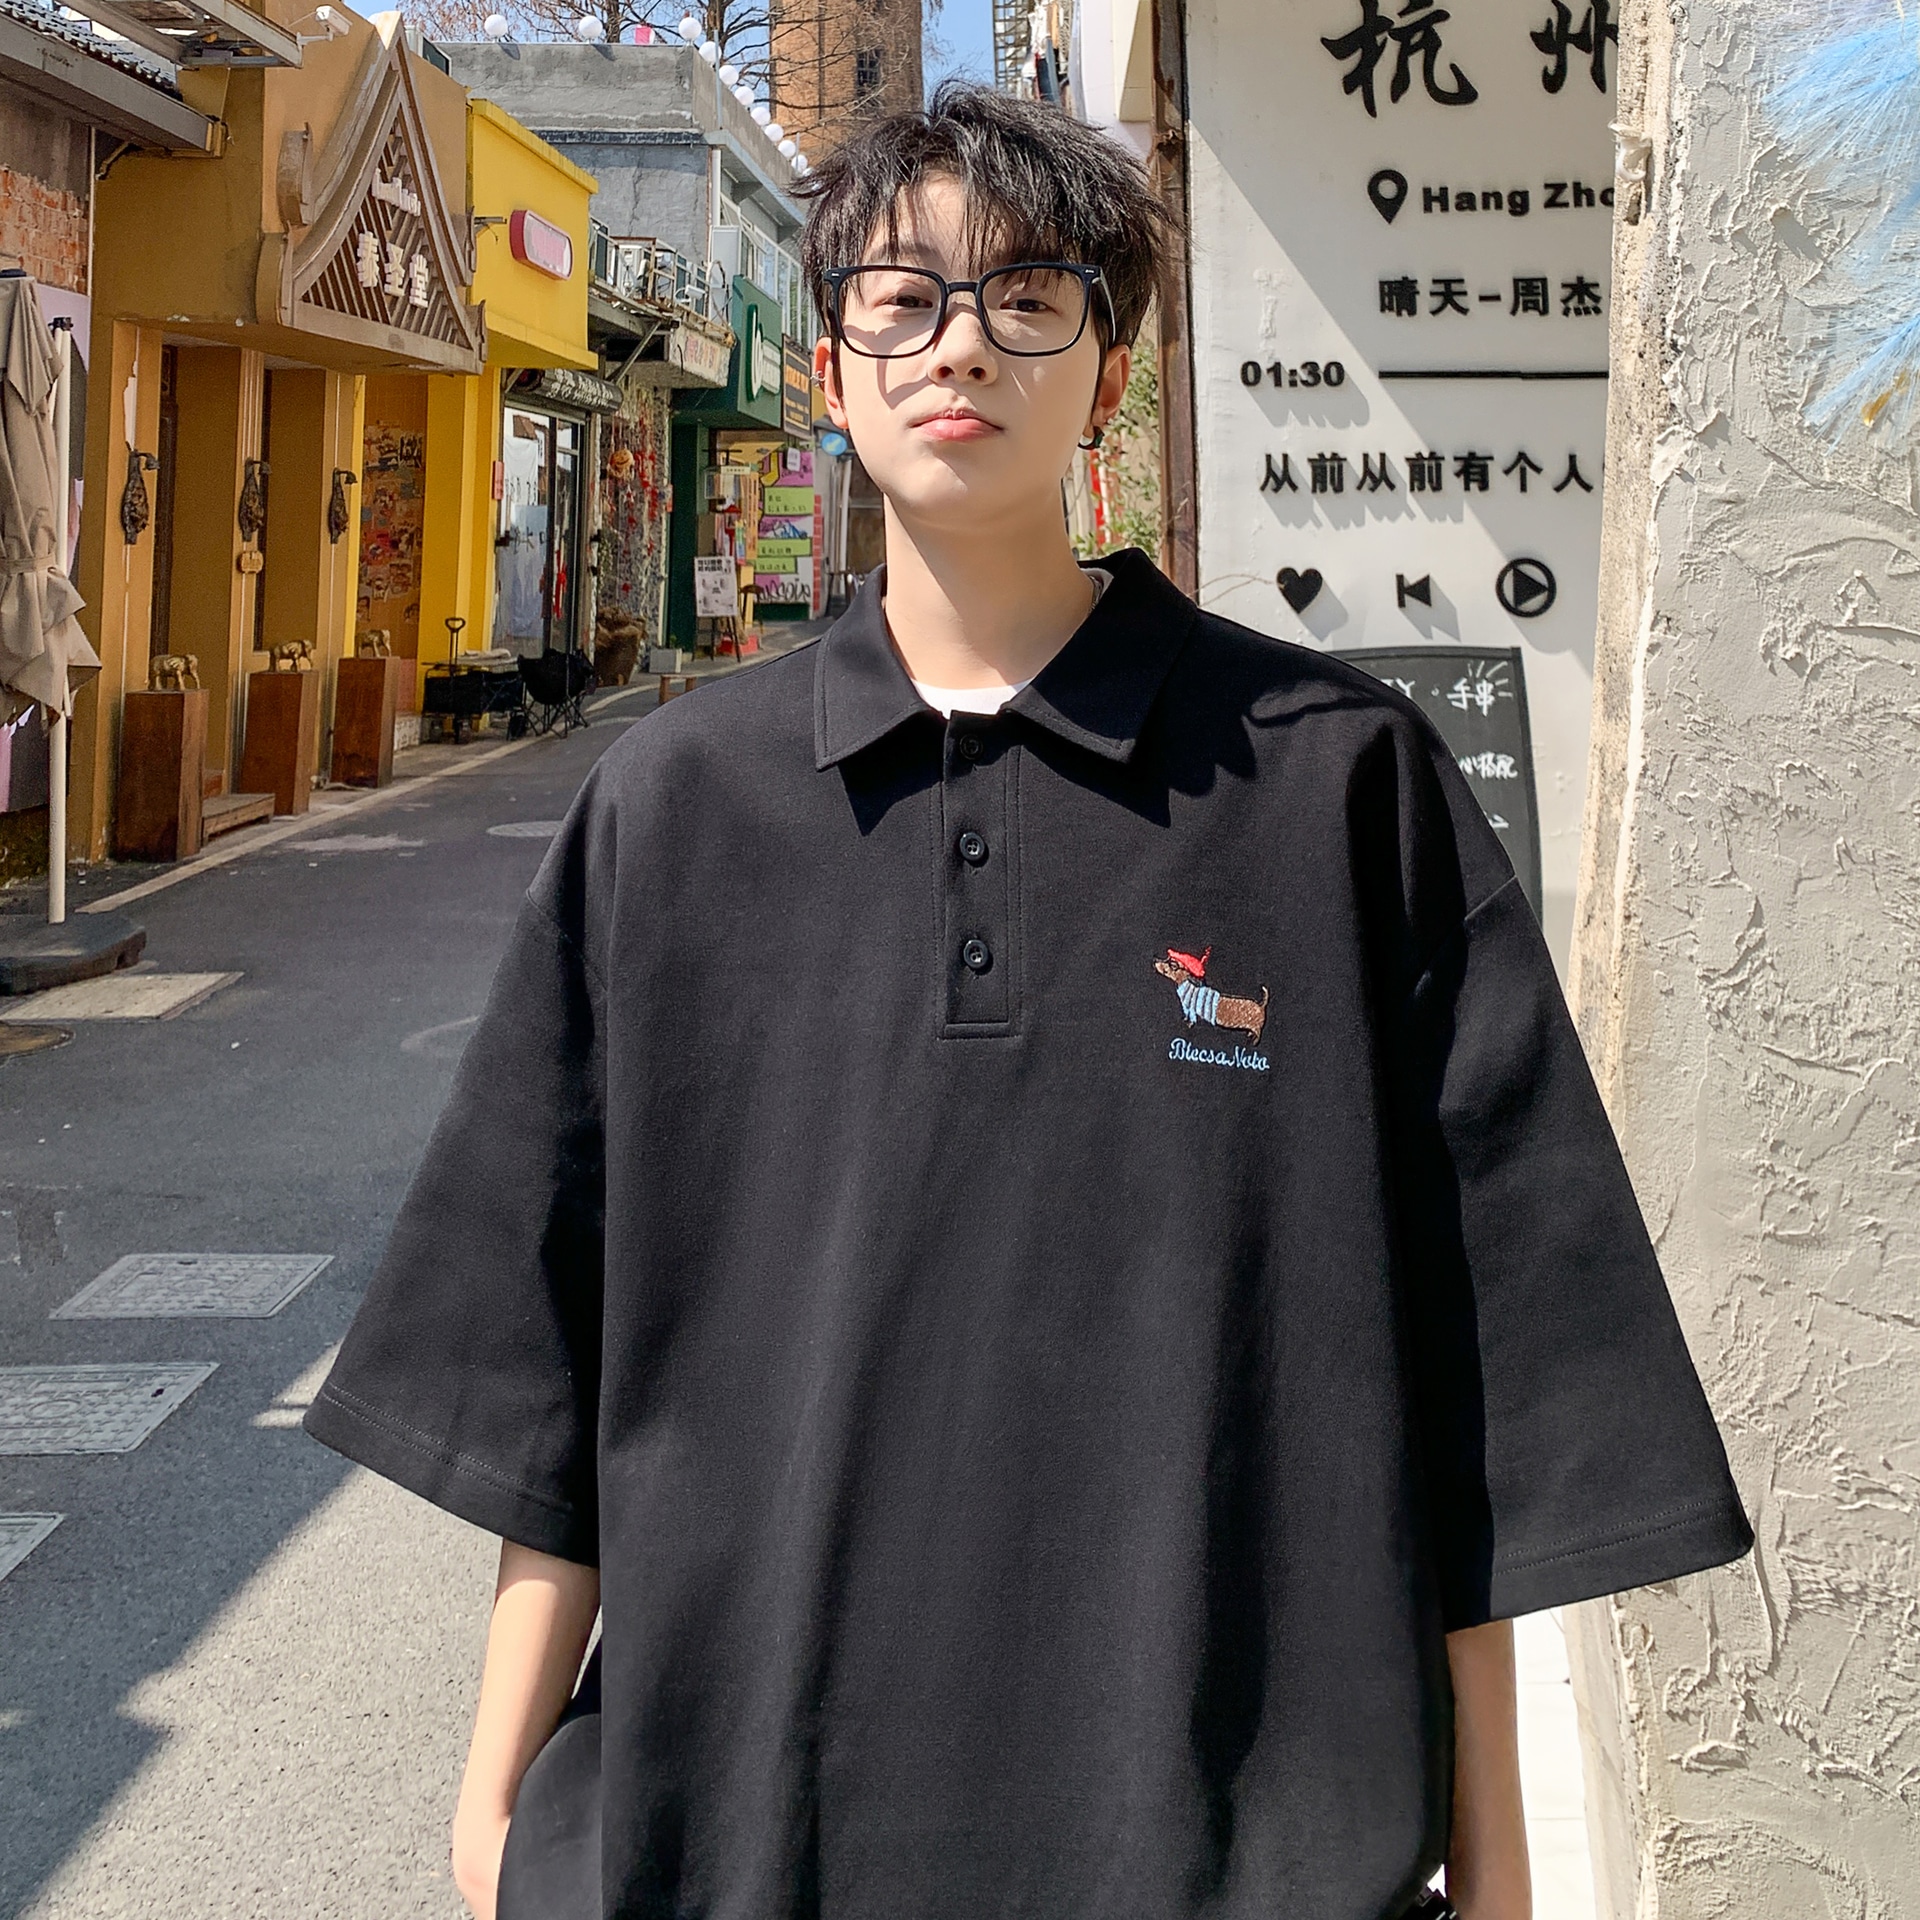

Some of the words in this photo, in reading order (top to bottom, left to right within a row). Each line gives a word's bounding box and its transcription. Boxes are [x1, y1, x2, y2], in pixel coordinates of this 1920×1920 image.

[1422, 183, 1531, 217] Hang
[1240, 361, 1346, 388] 01:30
[1260, 451, 1606, 494] 从前从前有个人
